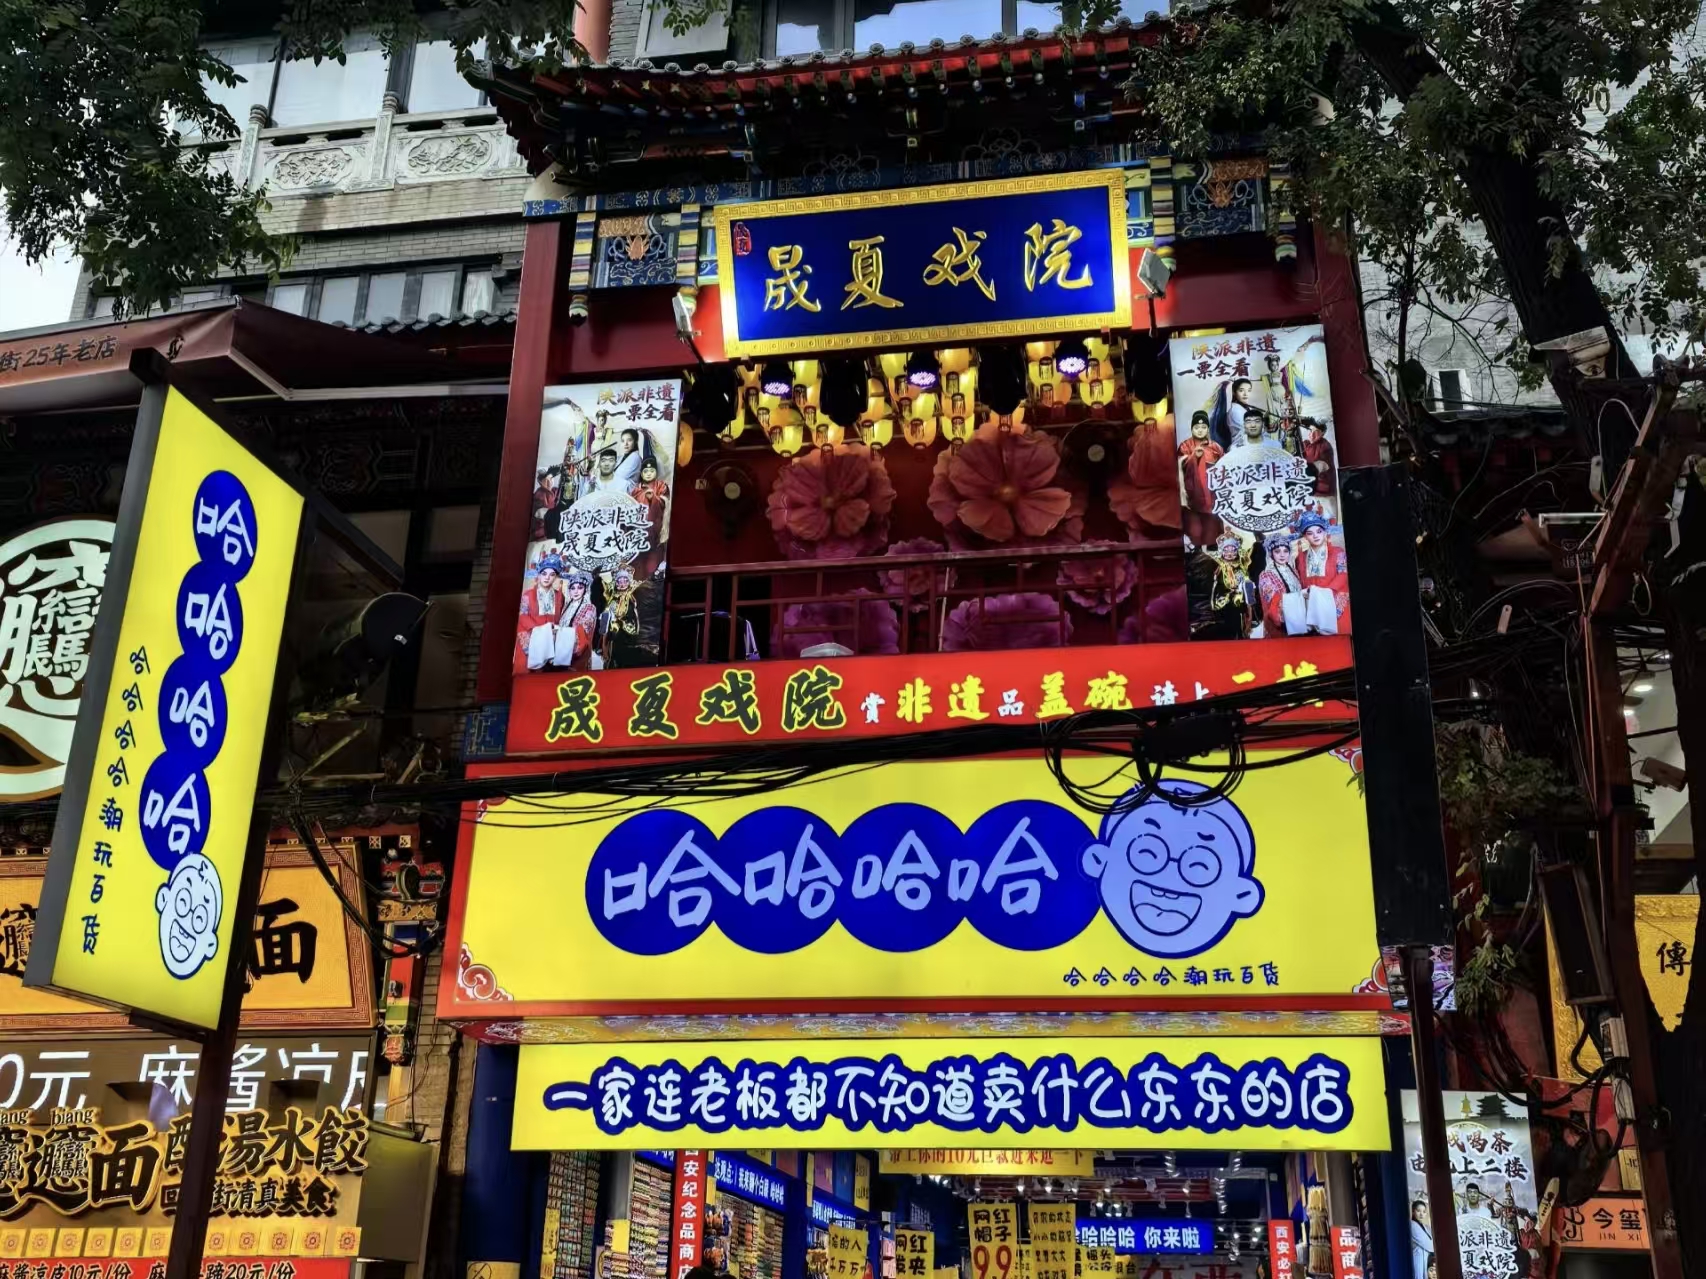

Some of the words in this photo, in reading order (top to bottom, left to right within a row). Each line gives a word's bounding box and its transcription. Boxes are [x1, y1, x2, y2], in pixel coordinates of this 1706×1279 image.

[764, 218, 1093, 312] 晟夏戏院
[1177, 357, 1251, 380] 一票全看
[609, 402, 677, 422] 一票全看
[1209, 458, 1315, 489] 陕派非遗
[1215, 486, 1314, 514] 晟夏戏院
[560, 505, 652, 531] 陕派非遗
[560, 529, 649, 555] 晟夏戏院
[144, 498, 254, 854] 哈哈哈哈
[82, 645, 150, 955] 哈哈哈哈潮玩百货
[603, 817, 1059, 928] 哈哈哈哈
[1063, 961, 1280, 987] 哈哈哈哈潮玩百货
[549, 1060, 1346, 1128] 一家连老板都不知道卖什么东东的店
[51, 1108, 94, 1125] biang
[160, 1176, 336, 1211] 回街清真美食
[973, 1209, 1012, 1225] 网红
[1592, 1207, 1643, 1230] 今玺
[1144, 1226, 1201, 1250] 你来啦
[1459, 1230, 1514, 1250] 派非遗
[1463, 1250, 1517, 1271] 夏戏院
